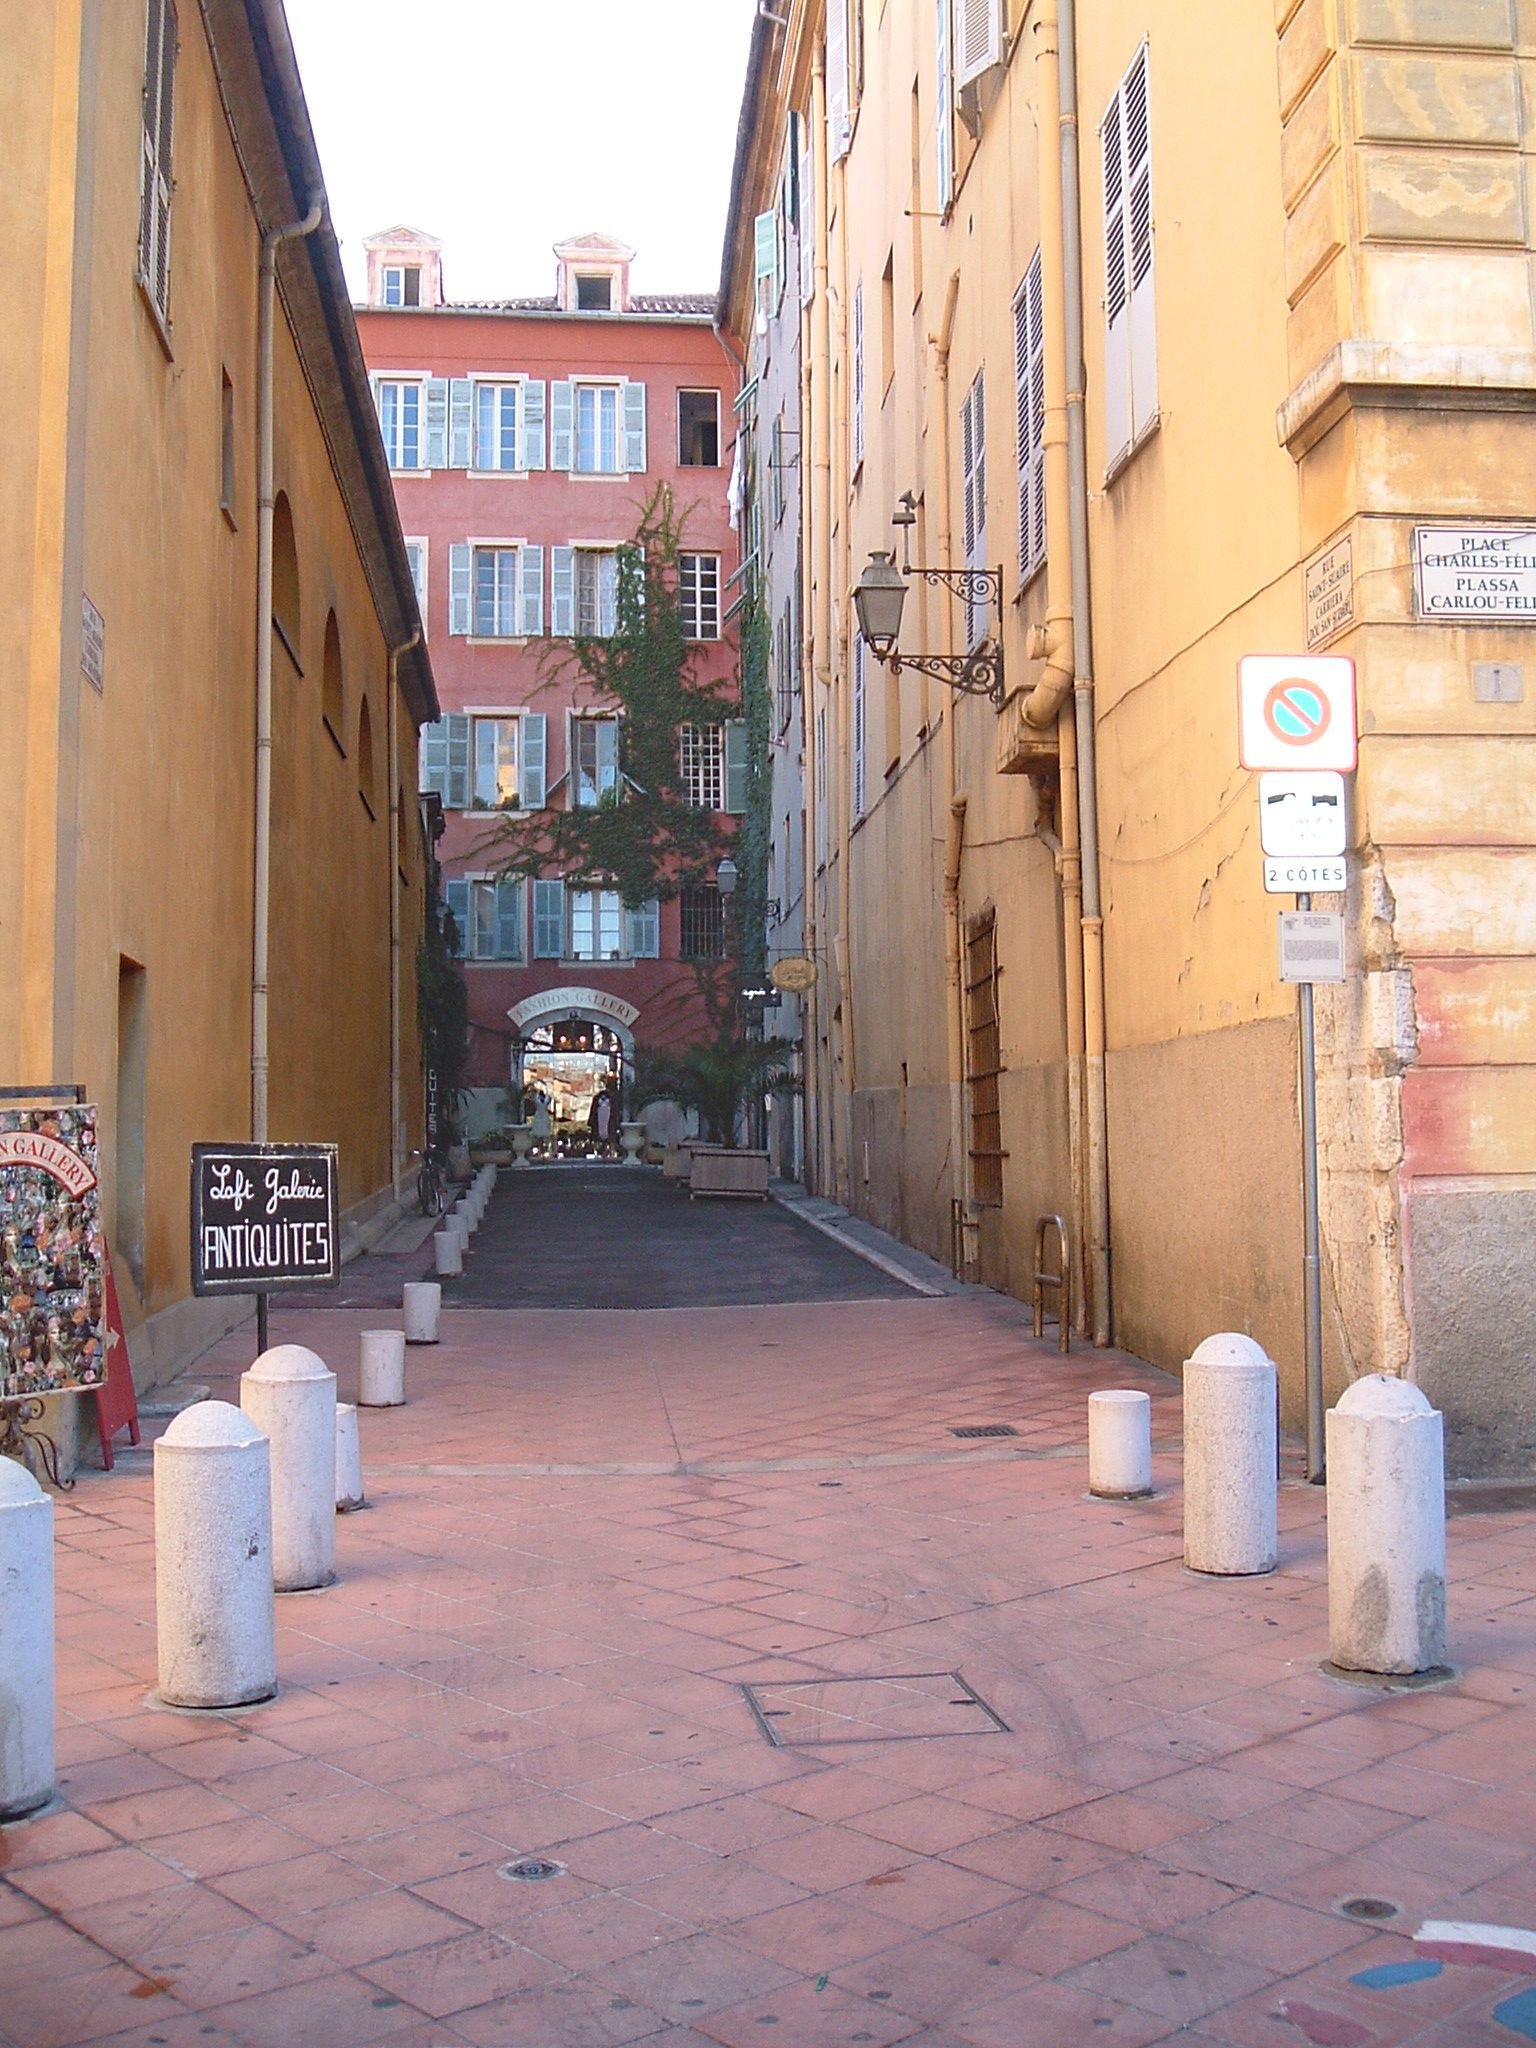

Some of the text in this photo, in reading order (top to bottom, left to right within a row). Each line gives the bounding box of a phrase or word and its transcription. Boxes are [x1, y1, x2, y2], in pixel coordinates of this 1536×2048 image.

[1461, 538, 1510, 551] PLACE
[1424, 553, 1536, 568] CHARLES-FÉLI
[1456, 578, 1519, 591] PLASSA
[1430, 595, 1536, 609] CARLOU-FELI
[1269, 870, 1278, 882] 2
[516, 992, 633, 1019] FASHION GALLERY
[13, 1138, 89, 1186] GALLERY
[210, 1164, 254, 1211] Loft
